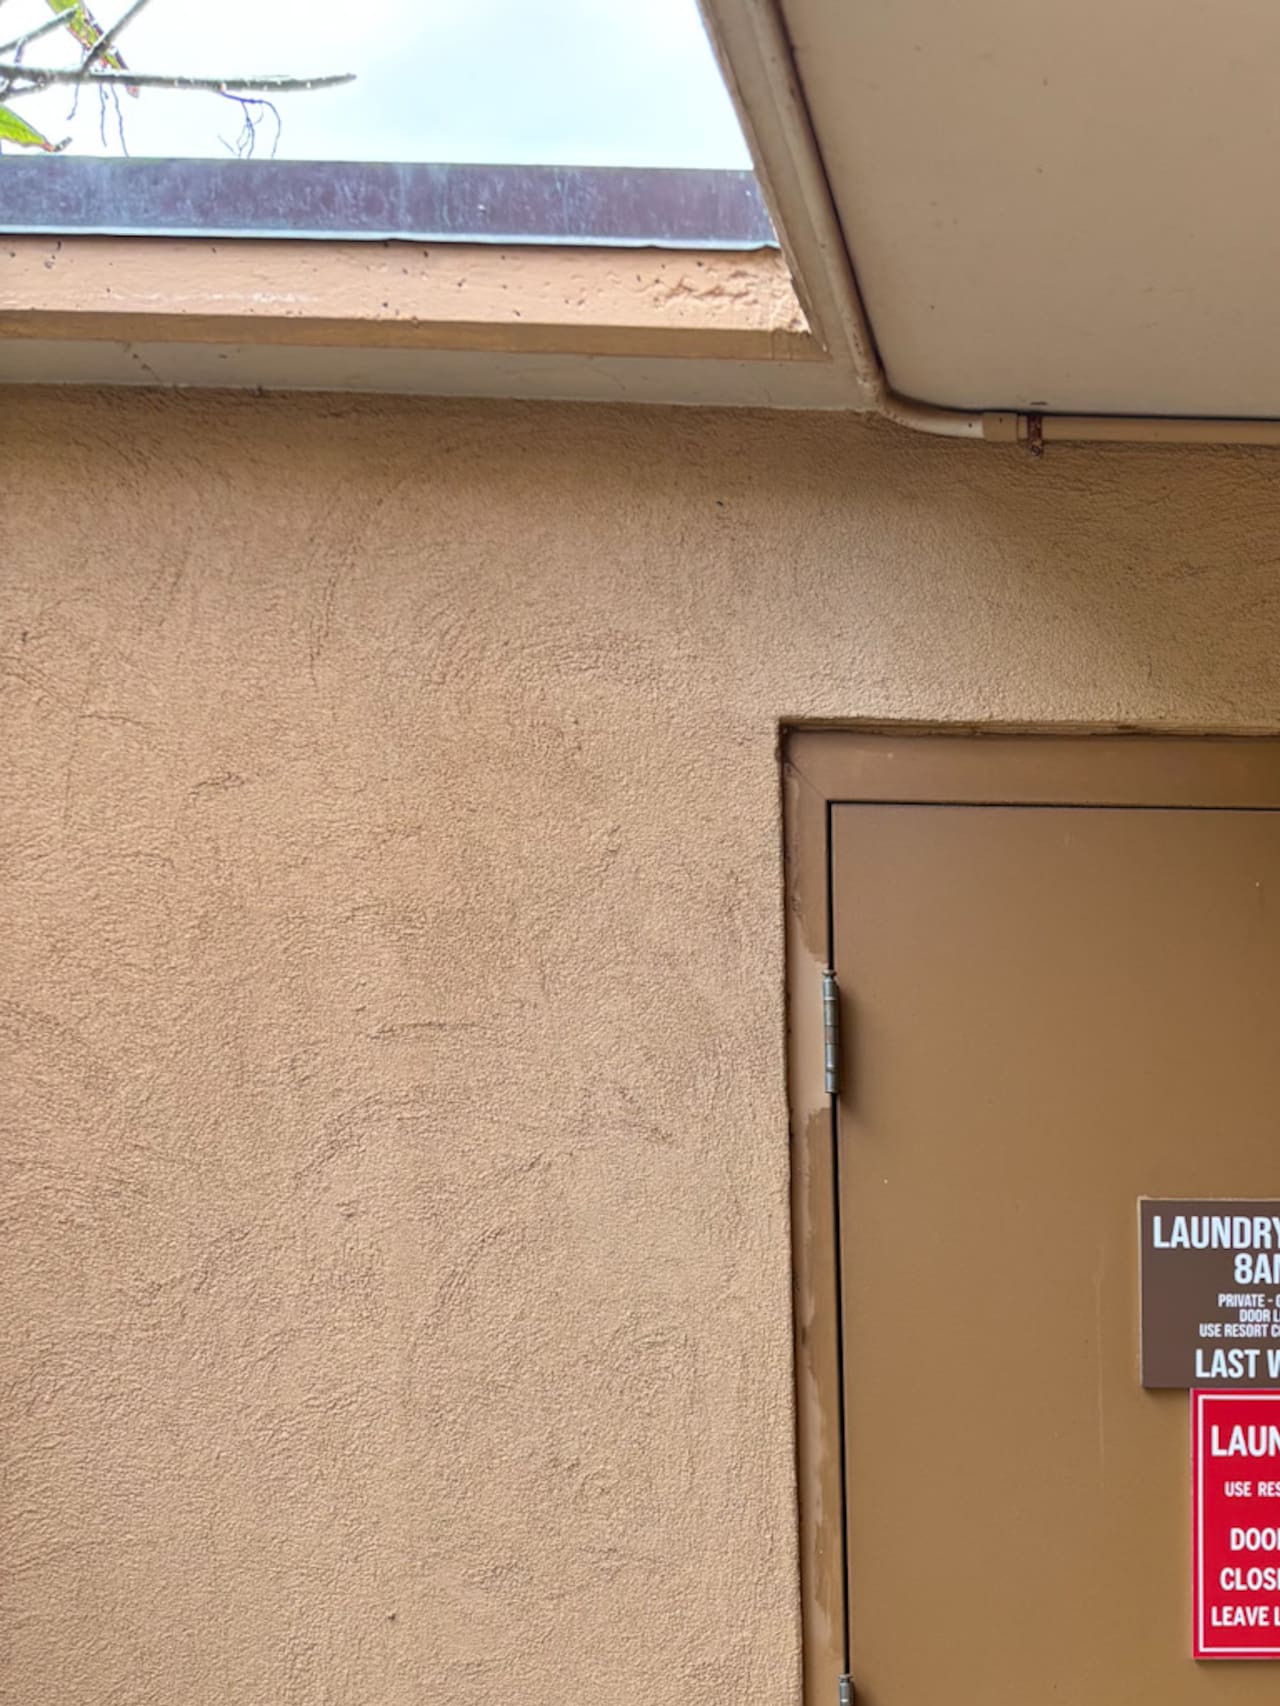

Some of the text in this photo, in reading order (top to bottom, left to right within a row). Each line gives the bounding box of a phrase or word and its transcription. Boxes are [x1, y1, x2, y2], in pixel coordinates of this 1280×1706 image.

[1218, 1293, 1265, 1308] PRIVATE
[1239, 1309, 1271, 1323] DOOR
[1199, 1323, 1222, 1337] USE
[1224, 1324, 1269, 1337] RESORT
[1195, 1349, 1260, 1378] LAST
[1224, 1481, 1251, 1497] USE
[1211, 1605, 1270, 1627] LEAVE
